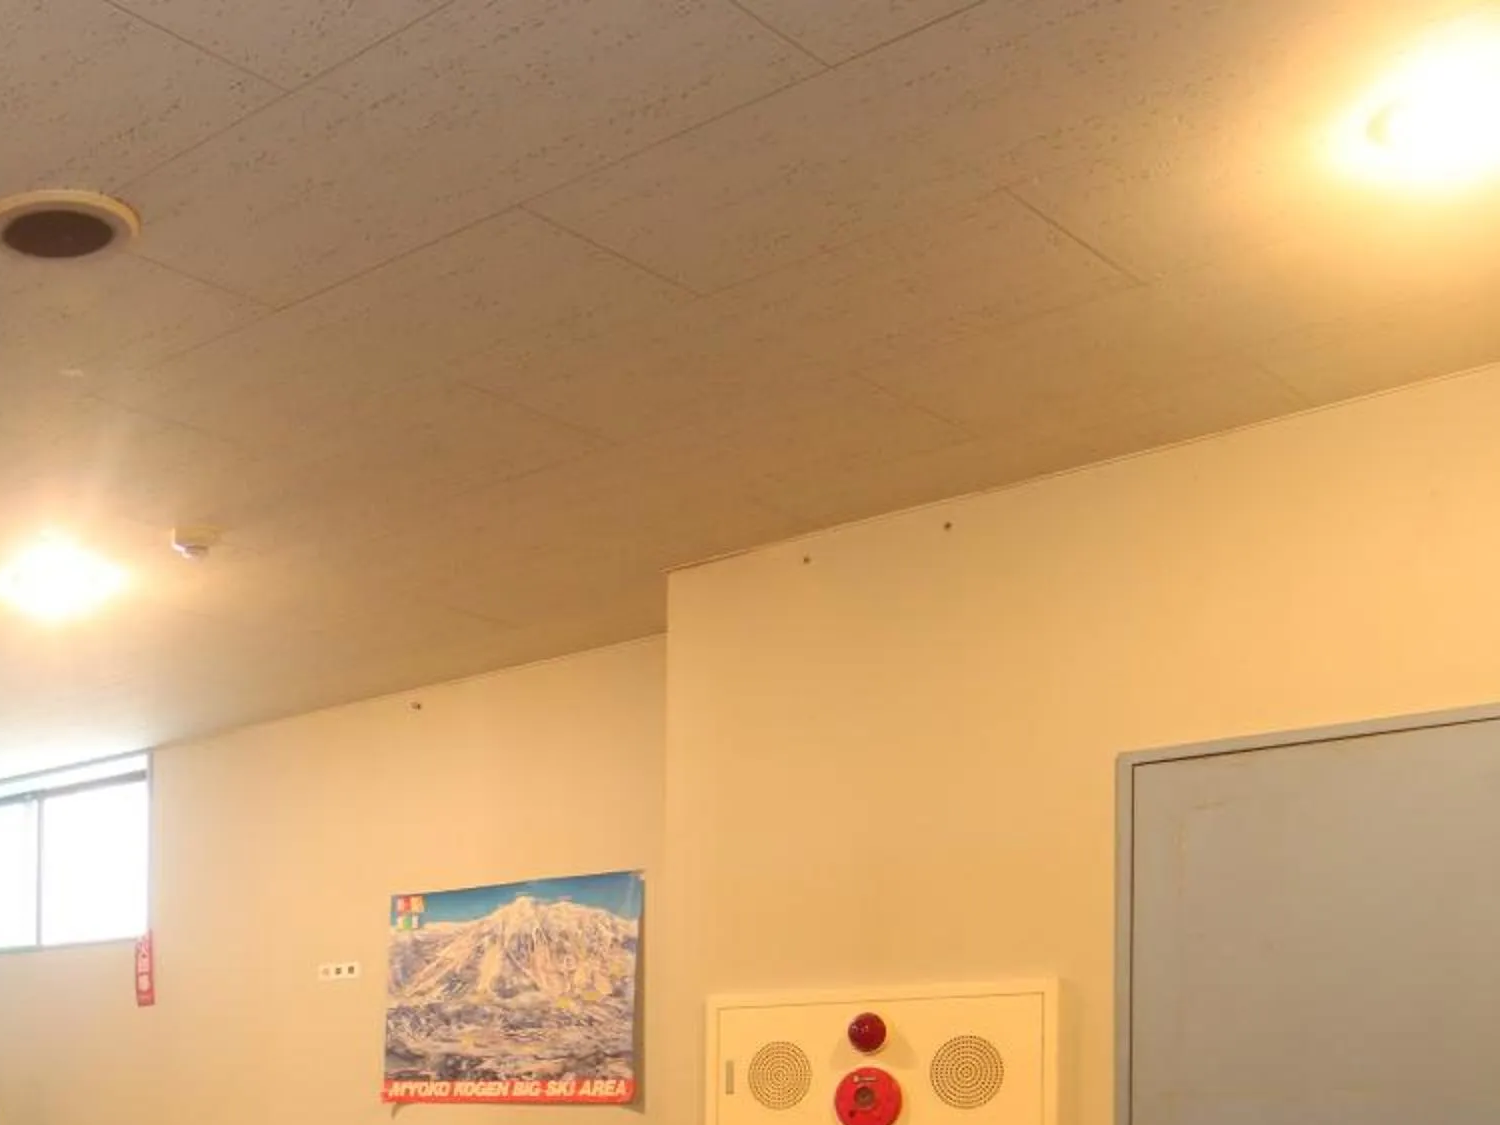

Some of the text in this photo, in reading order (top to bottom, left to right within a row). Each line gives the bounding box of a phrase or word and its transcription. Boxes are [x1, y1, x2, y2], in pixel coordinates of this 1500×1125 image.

[387, 1079, 451, 1098] MYOKO
[453, 1080, 511, 1097] KOGEN
[546, 1080, 575, 1097] SKI
[578, 1079, 628, 1097] AREA
